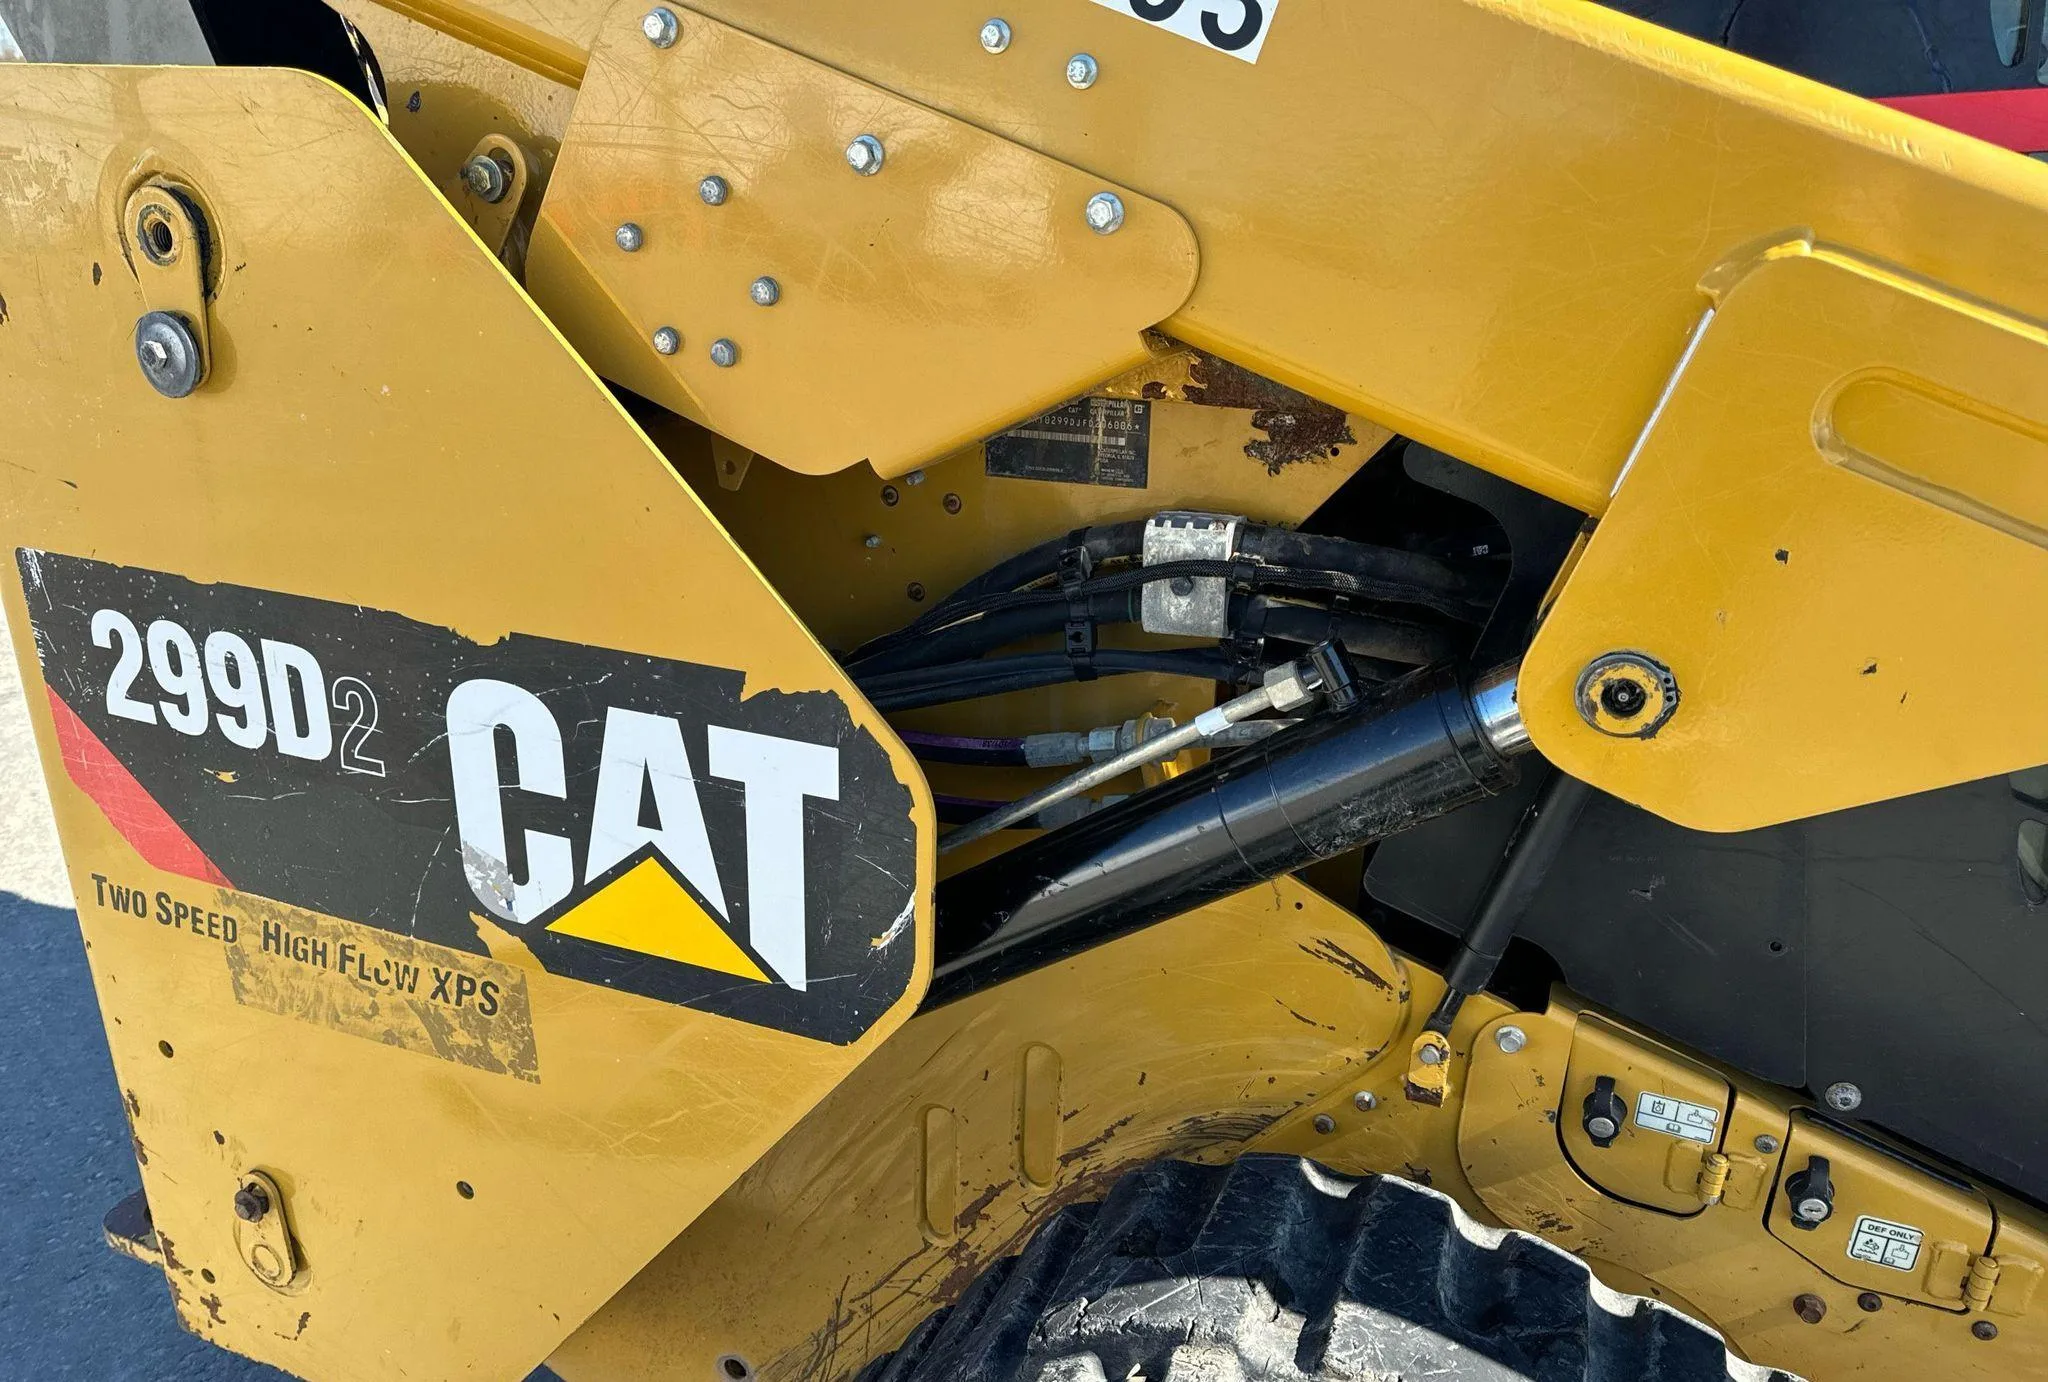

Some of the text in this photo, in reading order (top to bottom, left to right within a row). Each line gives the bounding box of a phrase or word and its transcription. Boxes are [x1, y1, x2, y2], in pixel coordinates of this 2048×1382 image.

[445, 678, 840, 992] CAT
[91, 873, 148, 919] TWO
[155, 891, 238, 944] SPEED
[262, 920, 328, 969] HIGH
[430, 967, 500, 1017] XPS
[1867, 1224, 1915, 1240] DEF ONLY
